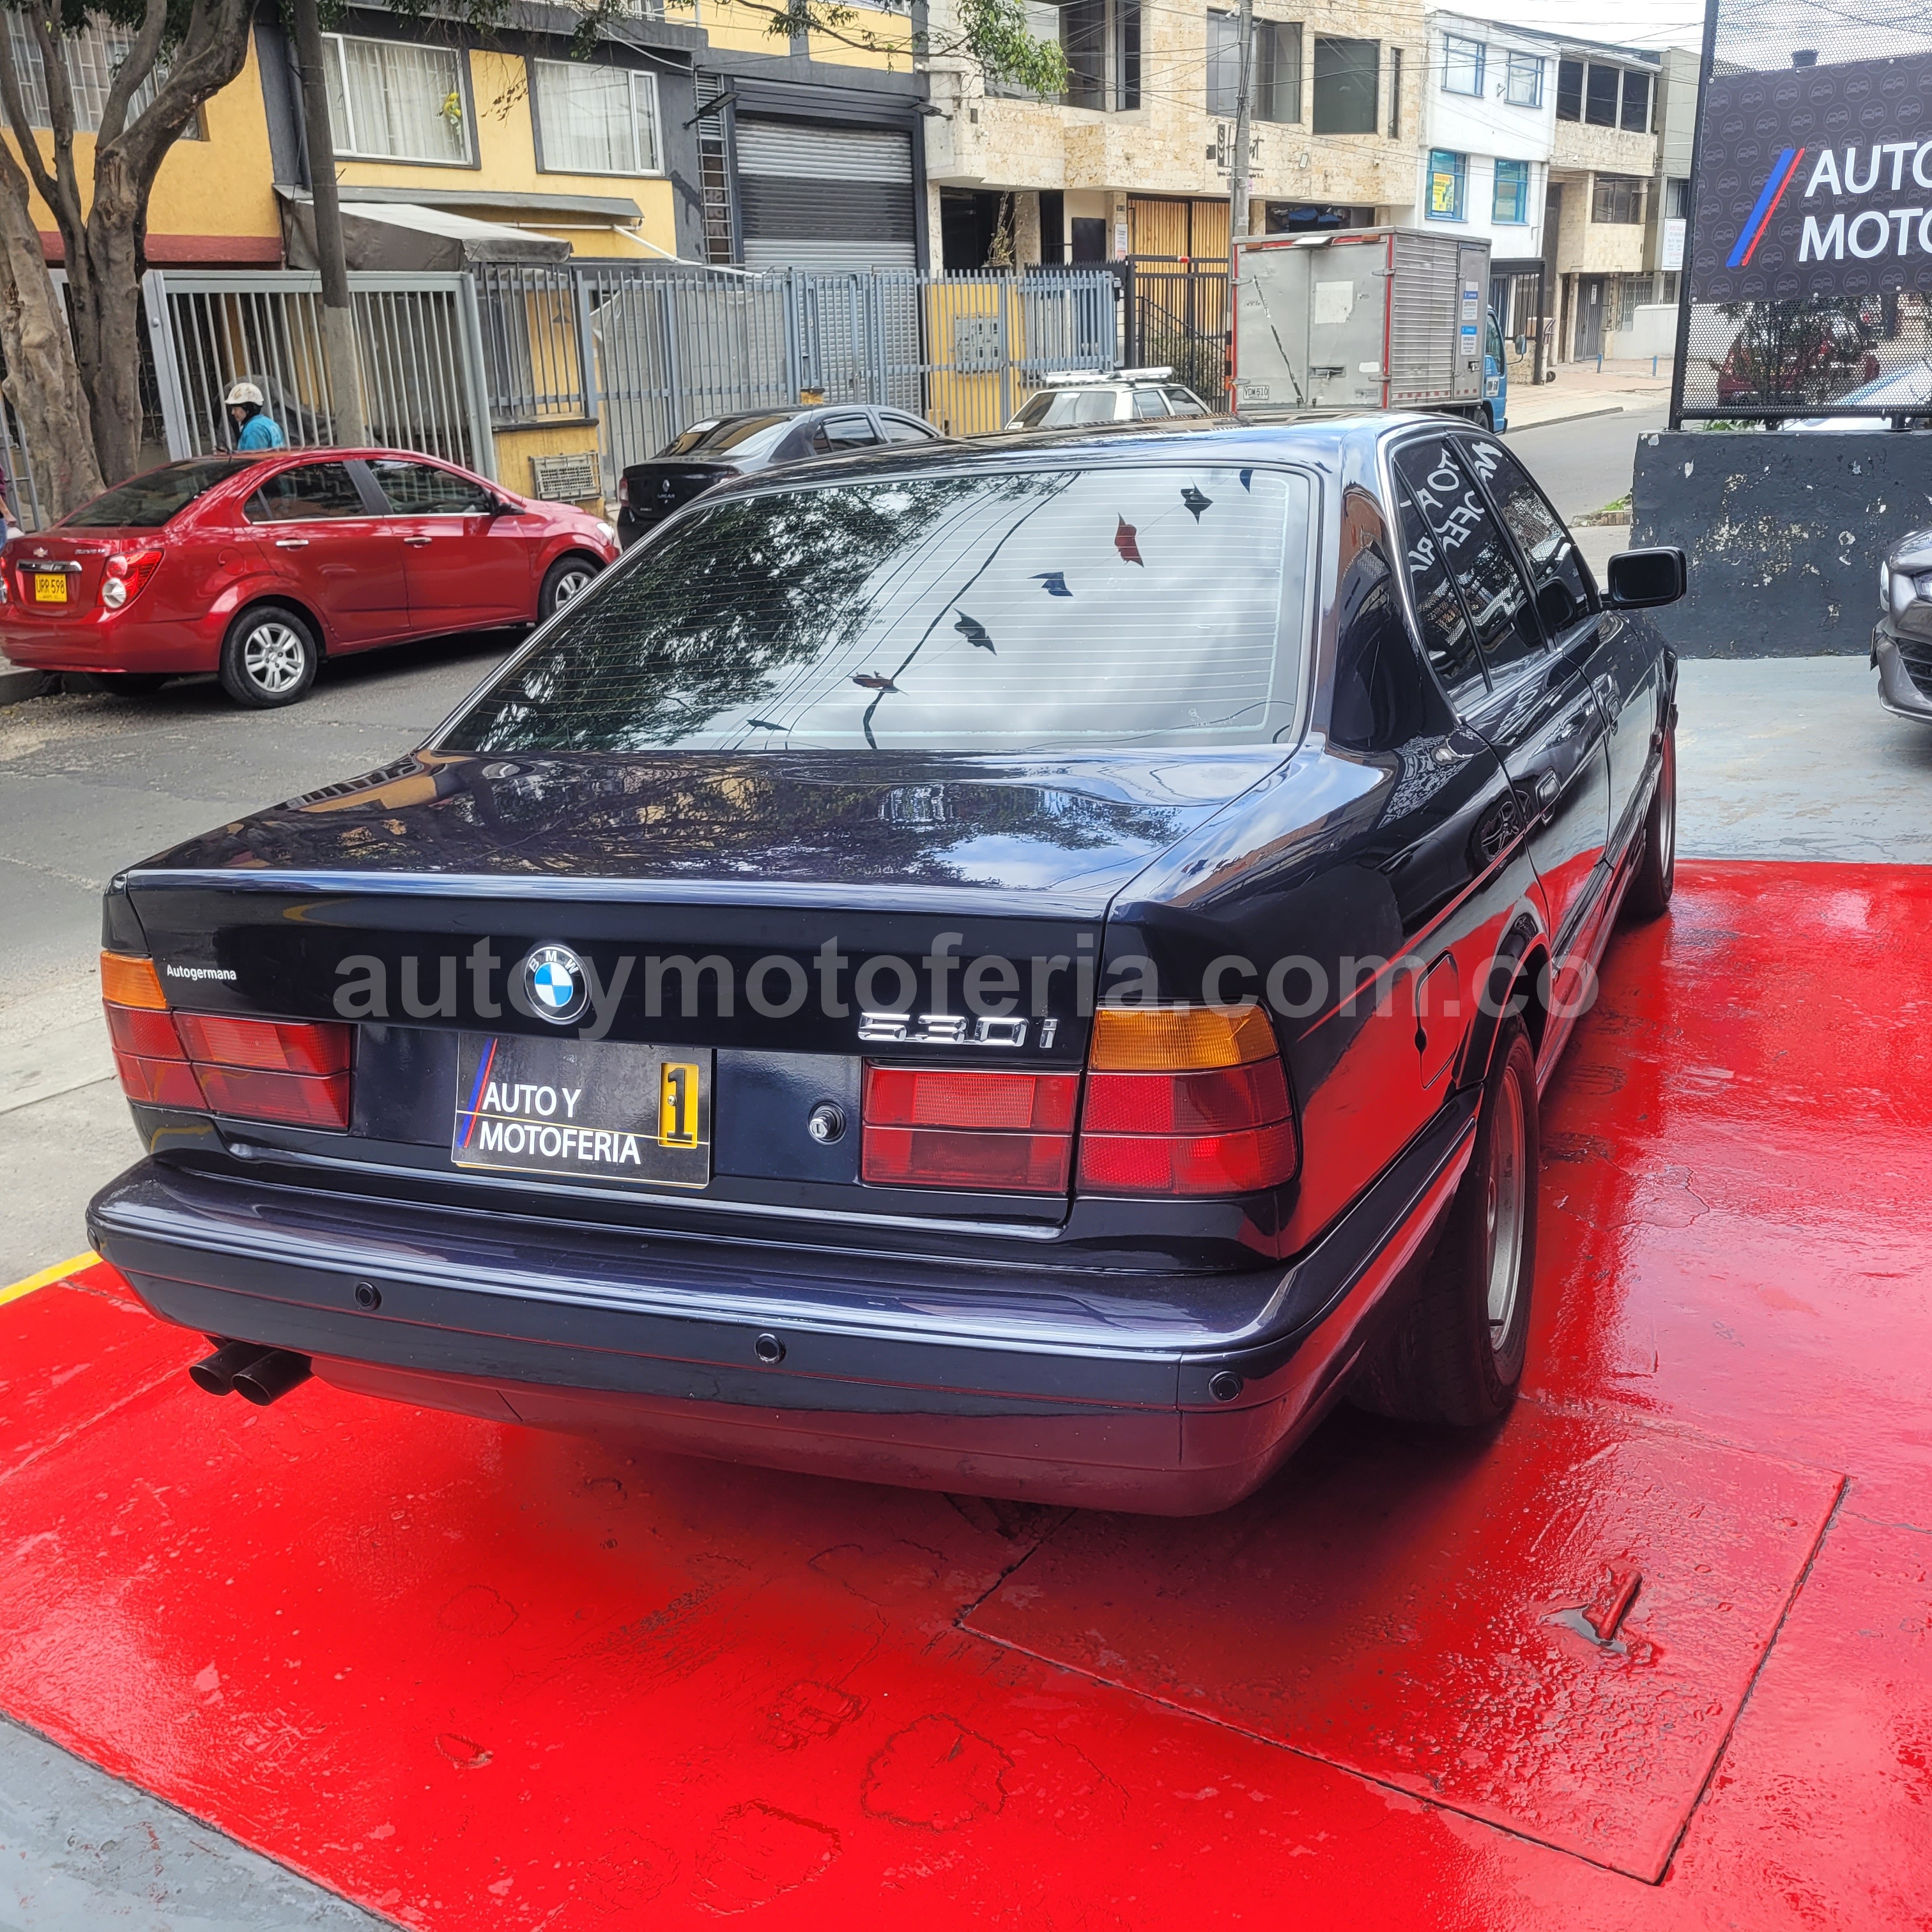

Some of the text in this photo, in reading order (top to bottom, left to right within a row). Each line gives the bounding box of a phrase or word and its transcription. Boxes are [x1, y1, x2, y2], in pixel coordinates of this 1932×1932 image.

[167, 963, 237, 981] Autogermana
[528, 950, 579, 974] BMW
[858, 1006, 1058, 1048] 530i
[482, 1081, 582, 1118] AUTO Y
[479, 1120, 642, 1165] MOTOFERIA
